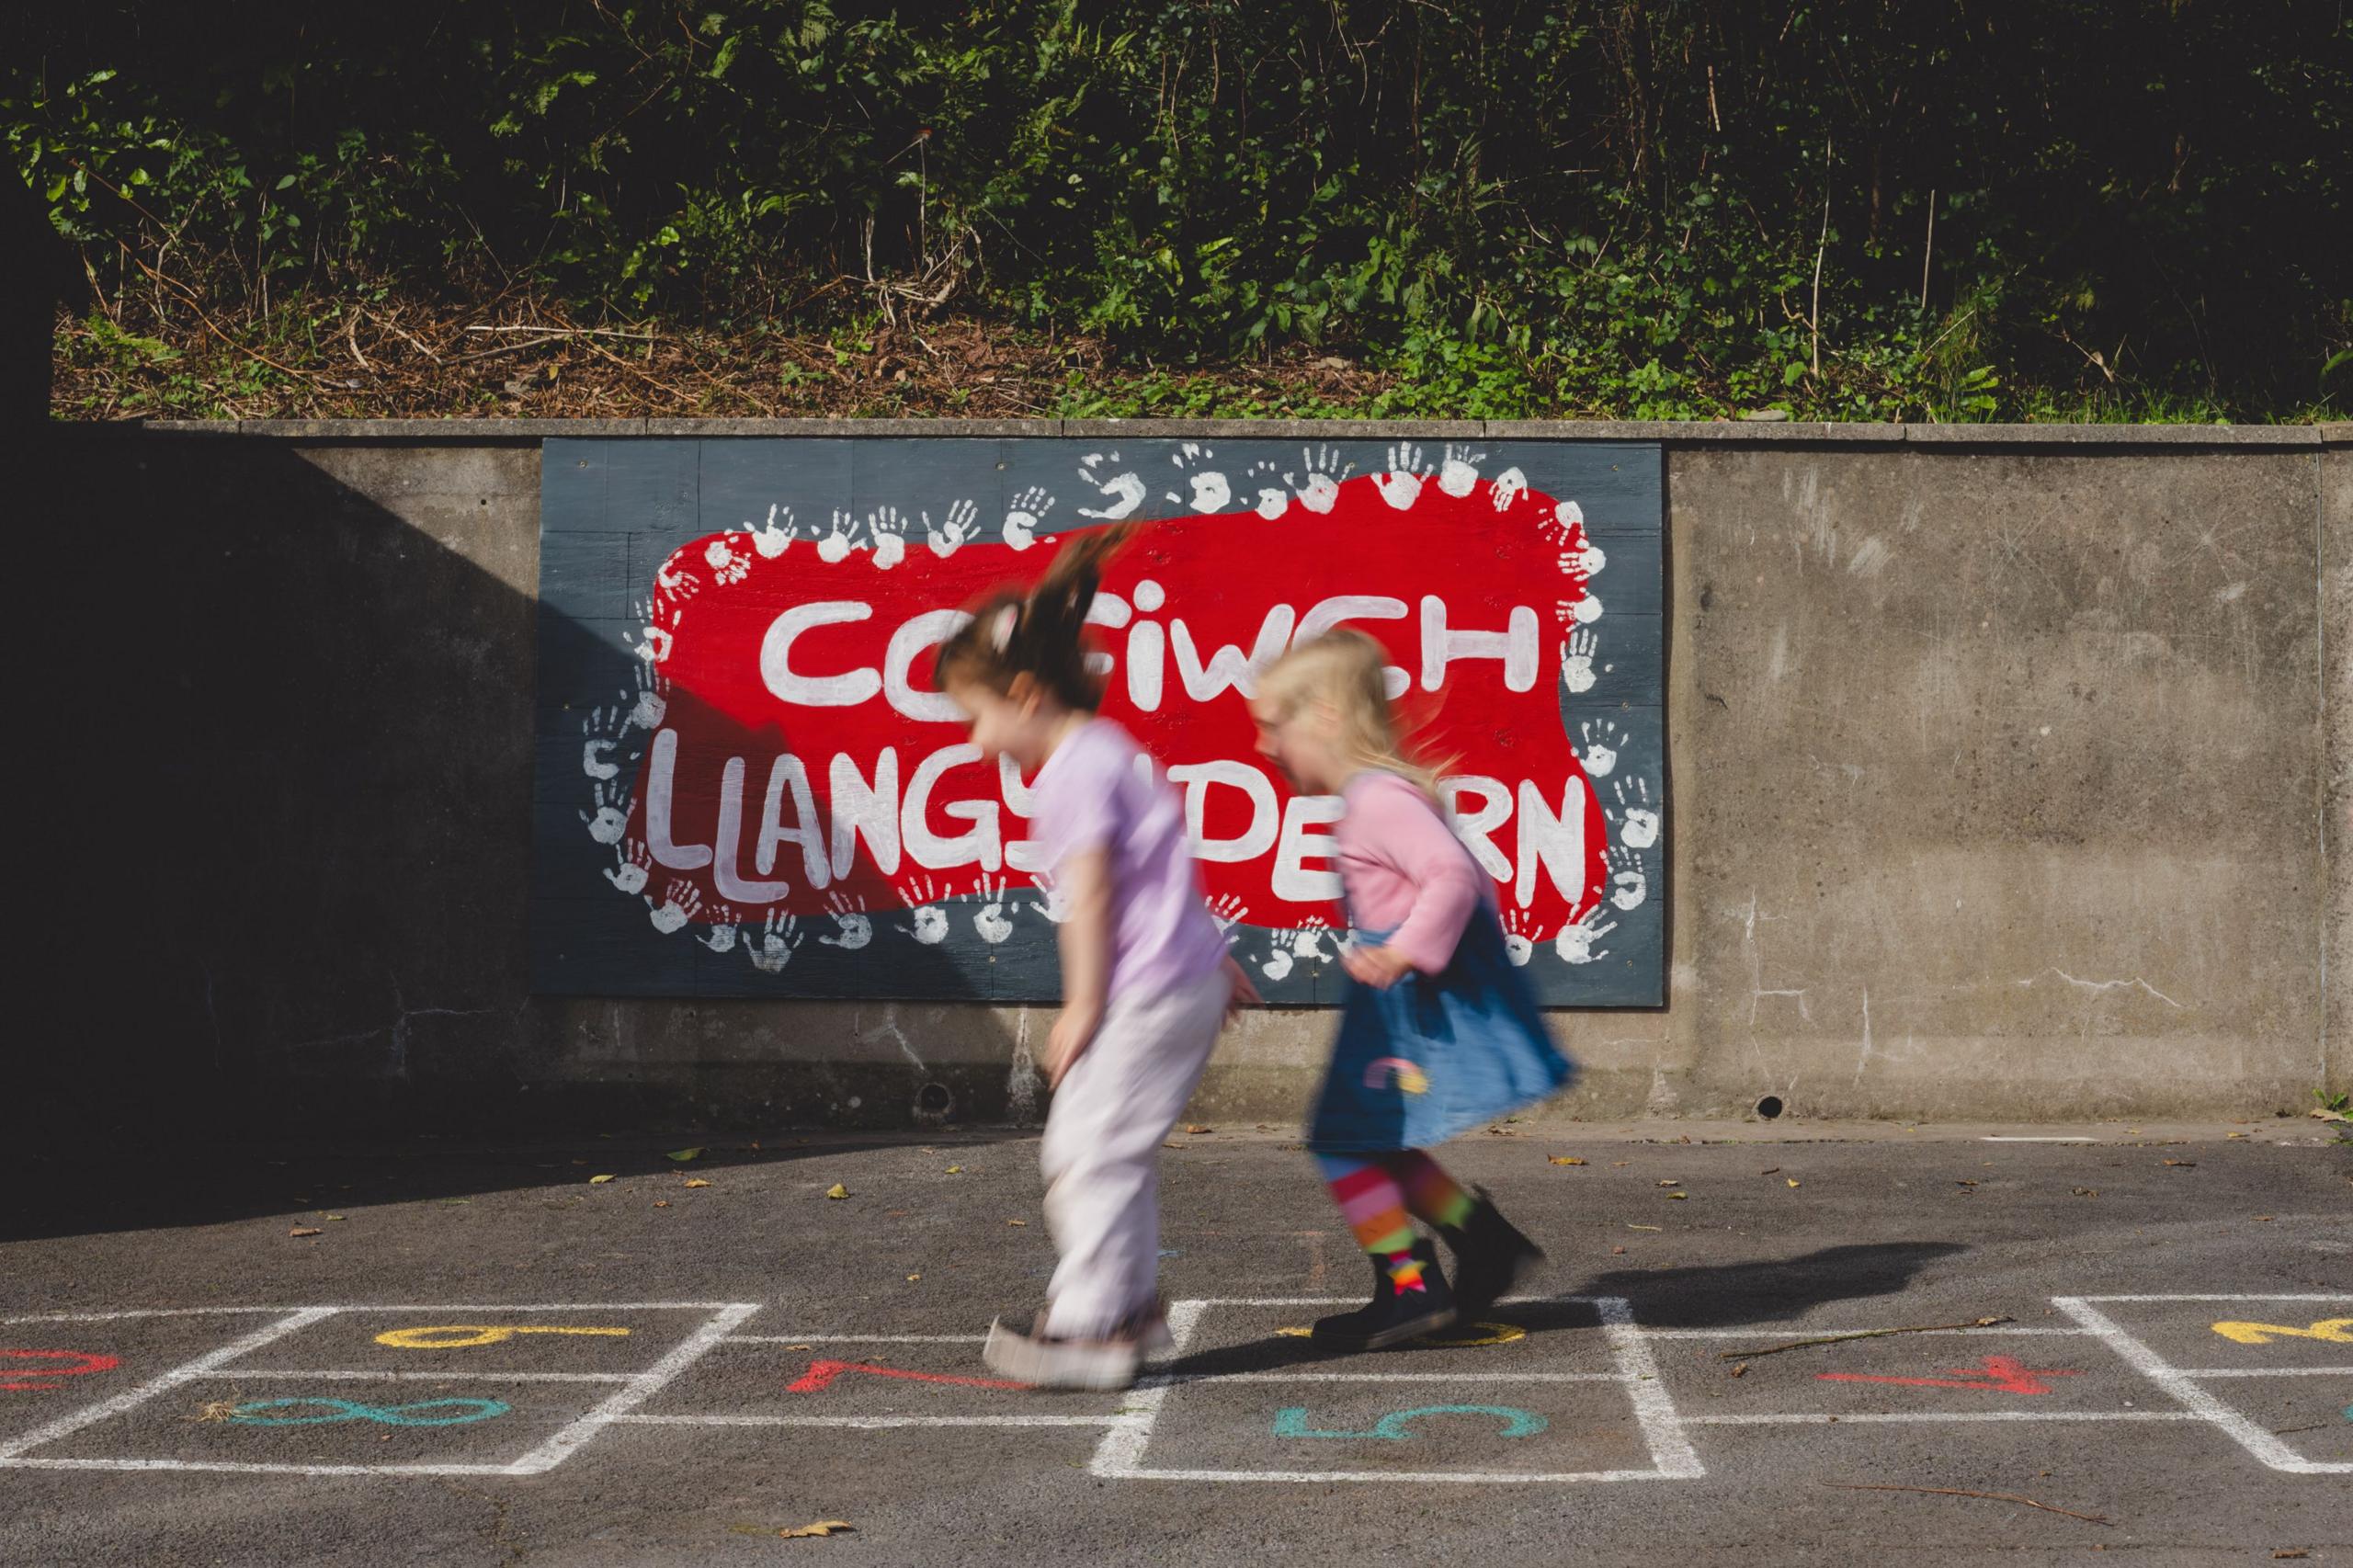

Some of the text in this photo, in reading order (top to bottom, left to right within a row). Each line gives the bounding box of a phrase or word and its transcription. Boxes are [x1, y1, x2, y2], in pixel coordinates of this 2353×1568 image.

[373, 1324, 632, 1350] 9
[230, 1397, 513, 1428] 8
[1272, 1404, 1548, 1441] 5
